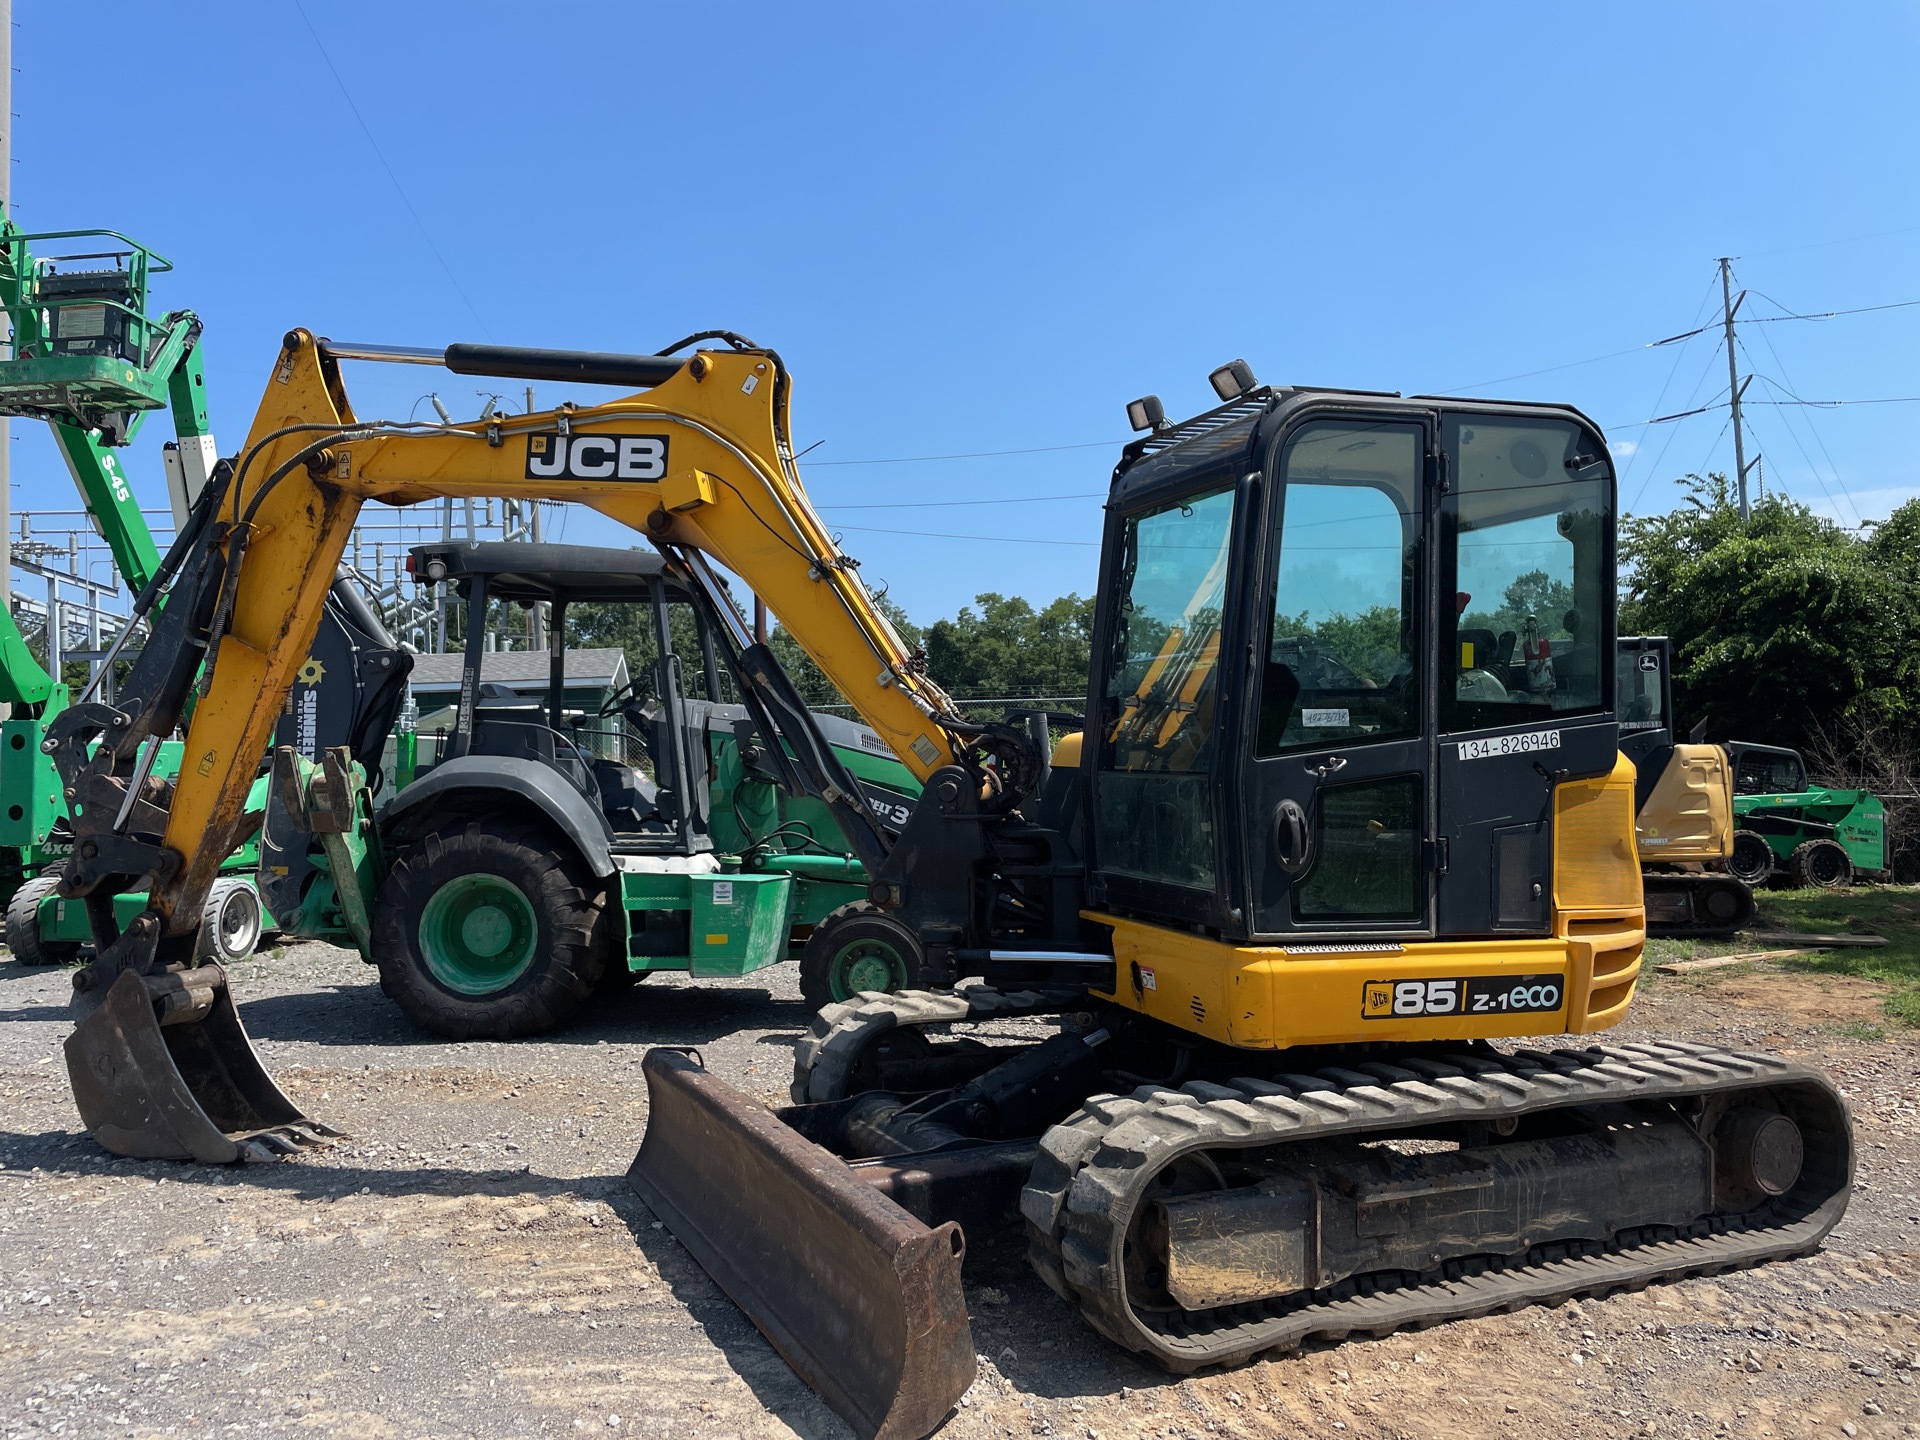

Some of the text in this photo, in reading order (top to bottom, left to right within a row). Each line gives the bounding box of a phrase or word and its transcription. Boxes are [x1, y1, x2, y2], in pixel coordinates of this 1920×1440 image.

[101, 454, 130, 502] S-45
[530, 436, 665, 479] JCB
[460, 667, 474, 732] 134-911544
[303, 690, 317, 764] SUNBELT
[1460, 732, 1559, 759] 134-826946
[41, 841, 75, 855] 4x4
[1372, 990, 1389, 1007] JCB
[1393, 980, 1457, 1015] 85
